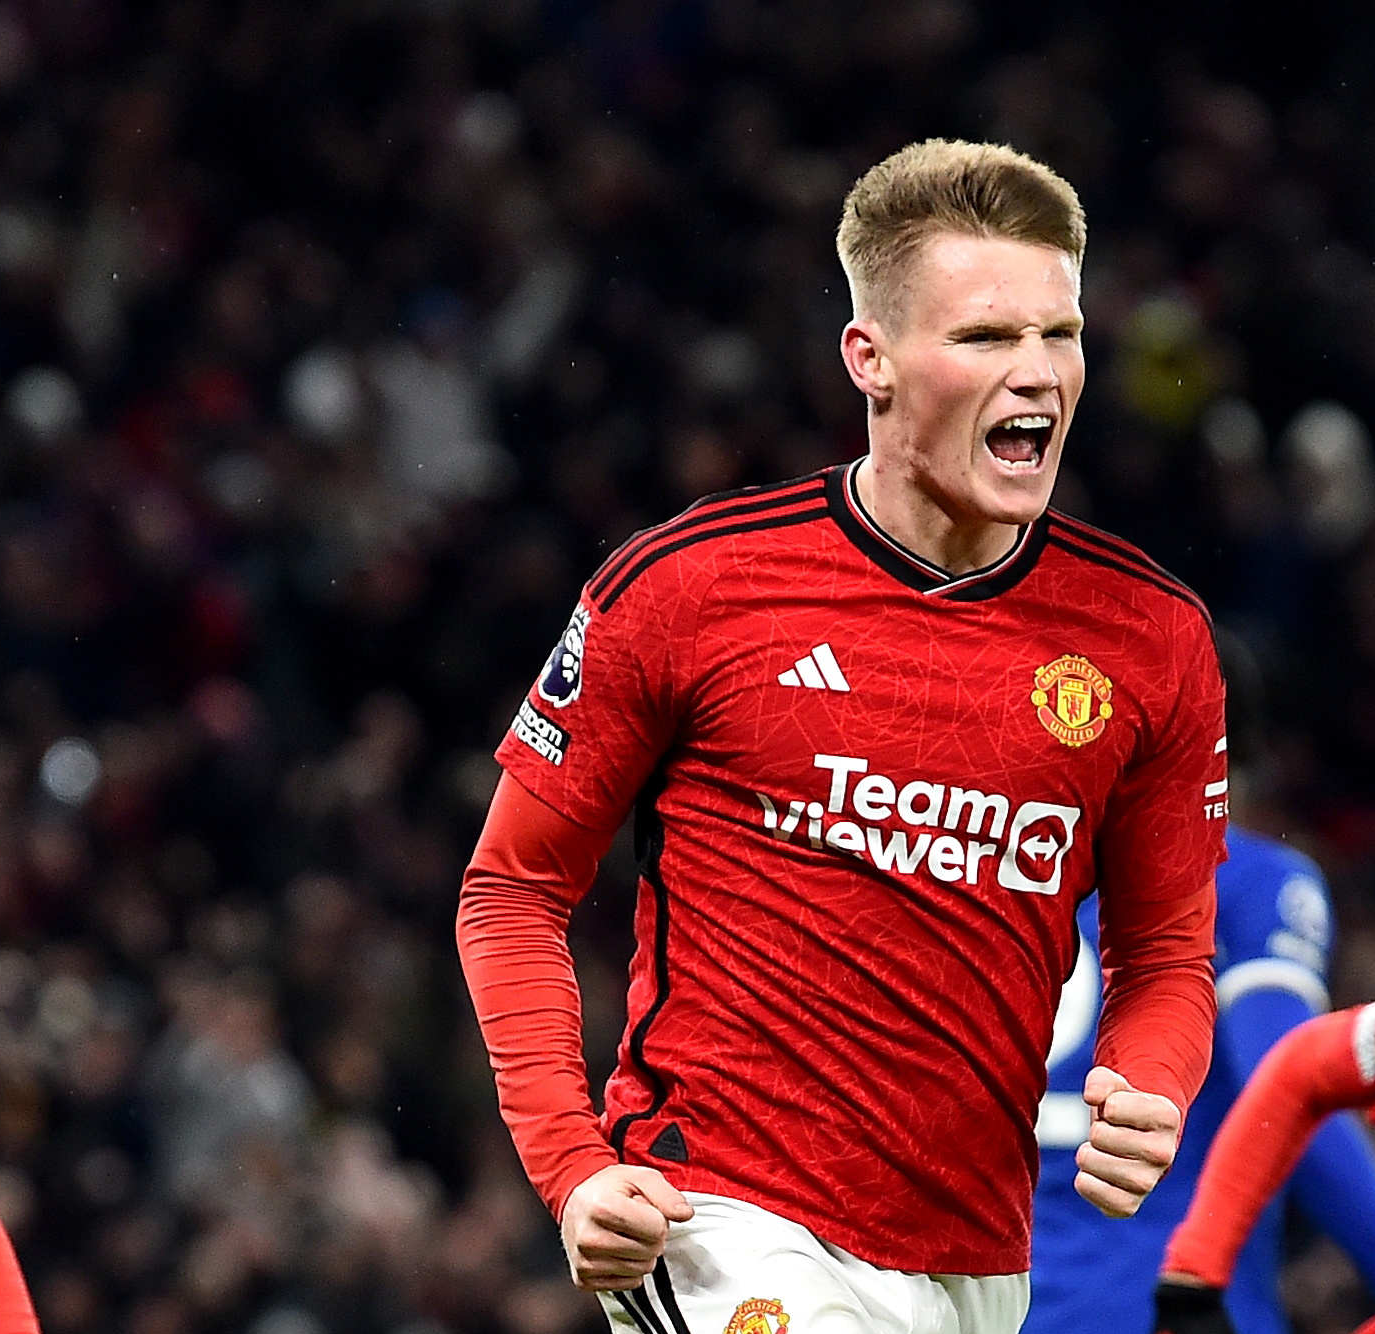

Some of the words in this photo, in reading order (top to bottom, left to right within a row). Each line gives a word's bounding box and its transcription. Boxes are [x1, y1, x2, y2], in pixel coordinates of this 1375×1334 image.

[1041, 661, 1107, 697] MANCHESTER
[1049, 720, 1095, 741] UNITED
[814, 753, 1009, 839] Team
[756, 792, 997, 885] Viewer
